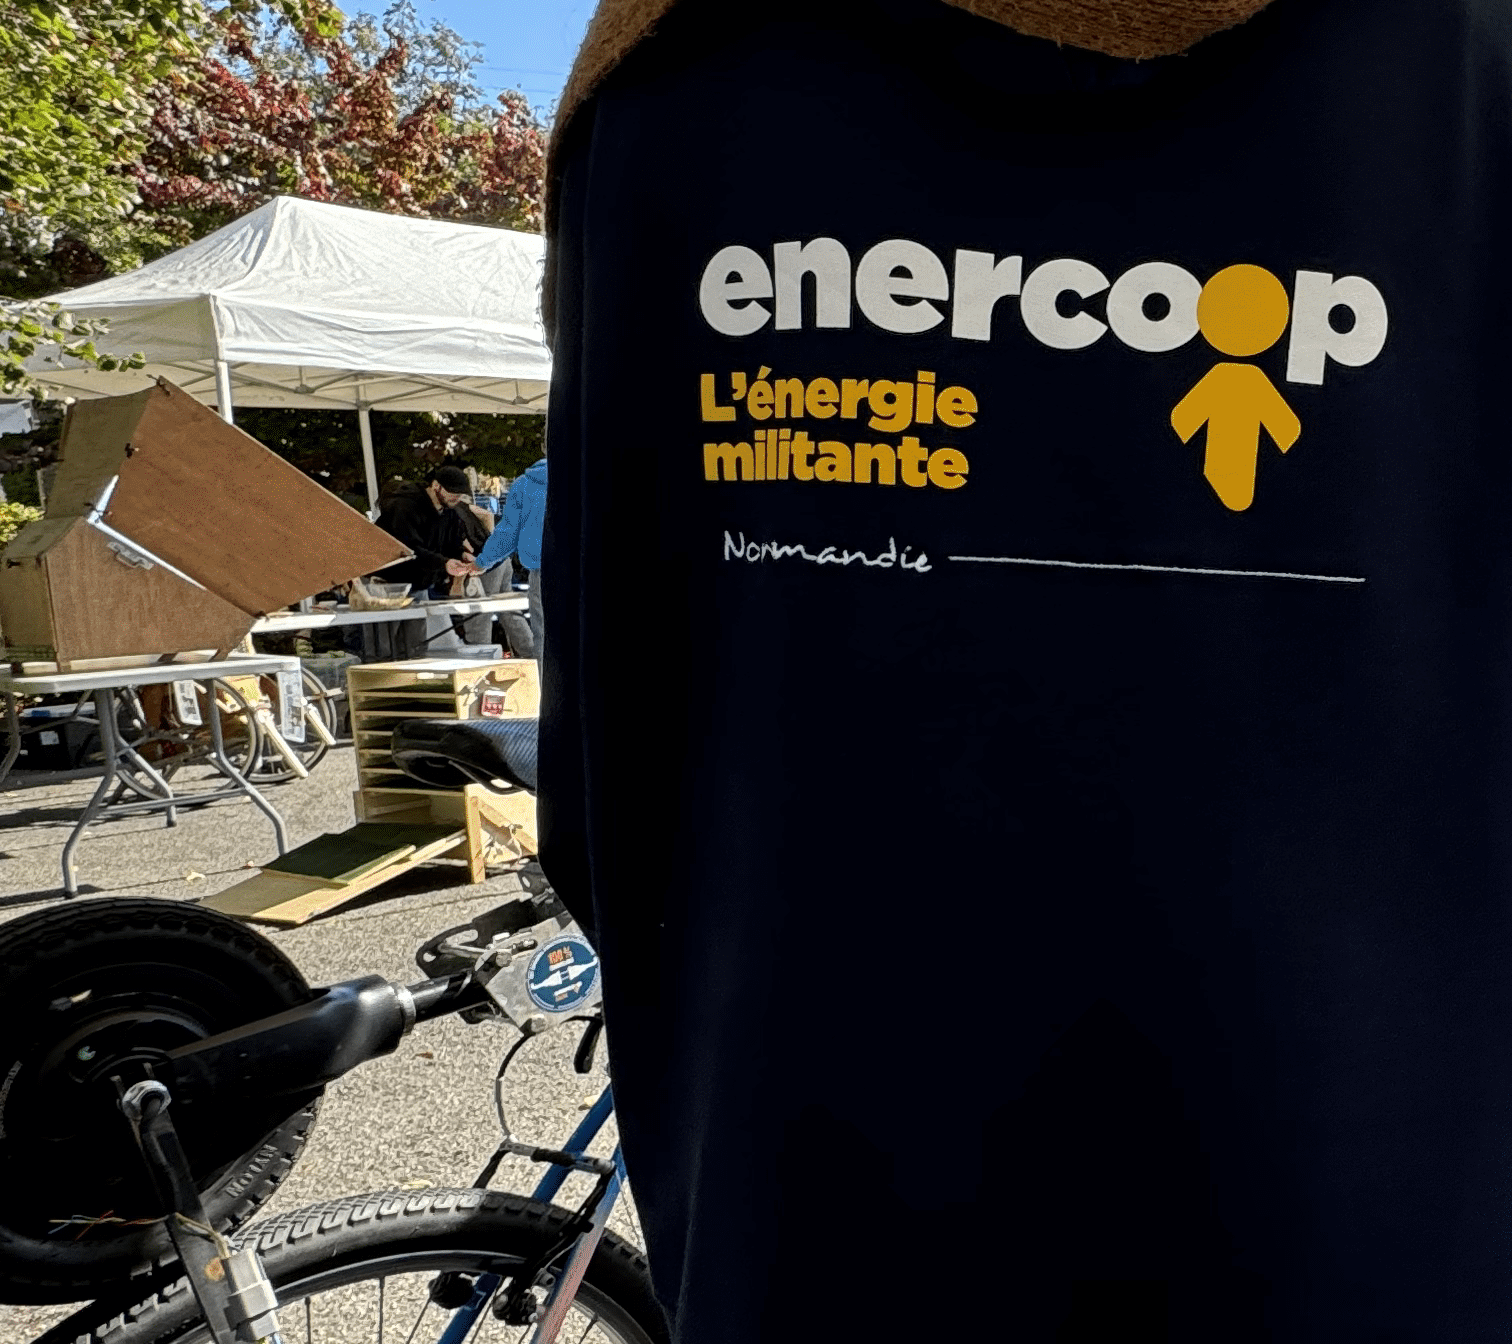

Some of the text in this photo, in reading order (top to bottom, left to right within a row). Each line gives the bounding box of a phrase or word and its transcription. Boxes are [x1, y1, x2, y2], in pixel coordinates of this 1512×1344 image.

[698, 236, 1390, 386] enercoop
[699, 364, 979, 433] L'énergie
[702, 428, 970, 490] militante
[722, 529, 933, 574] Normandie
